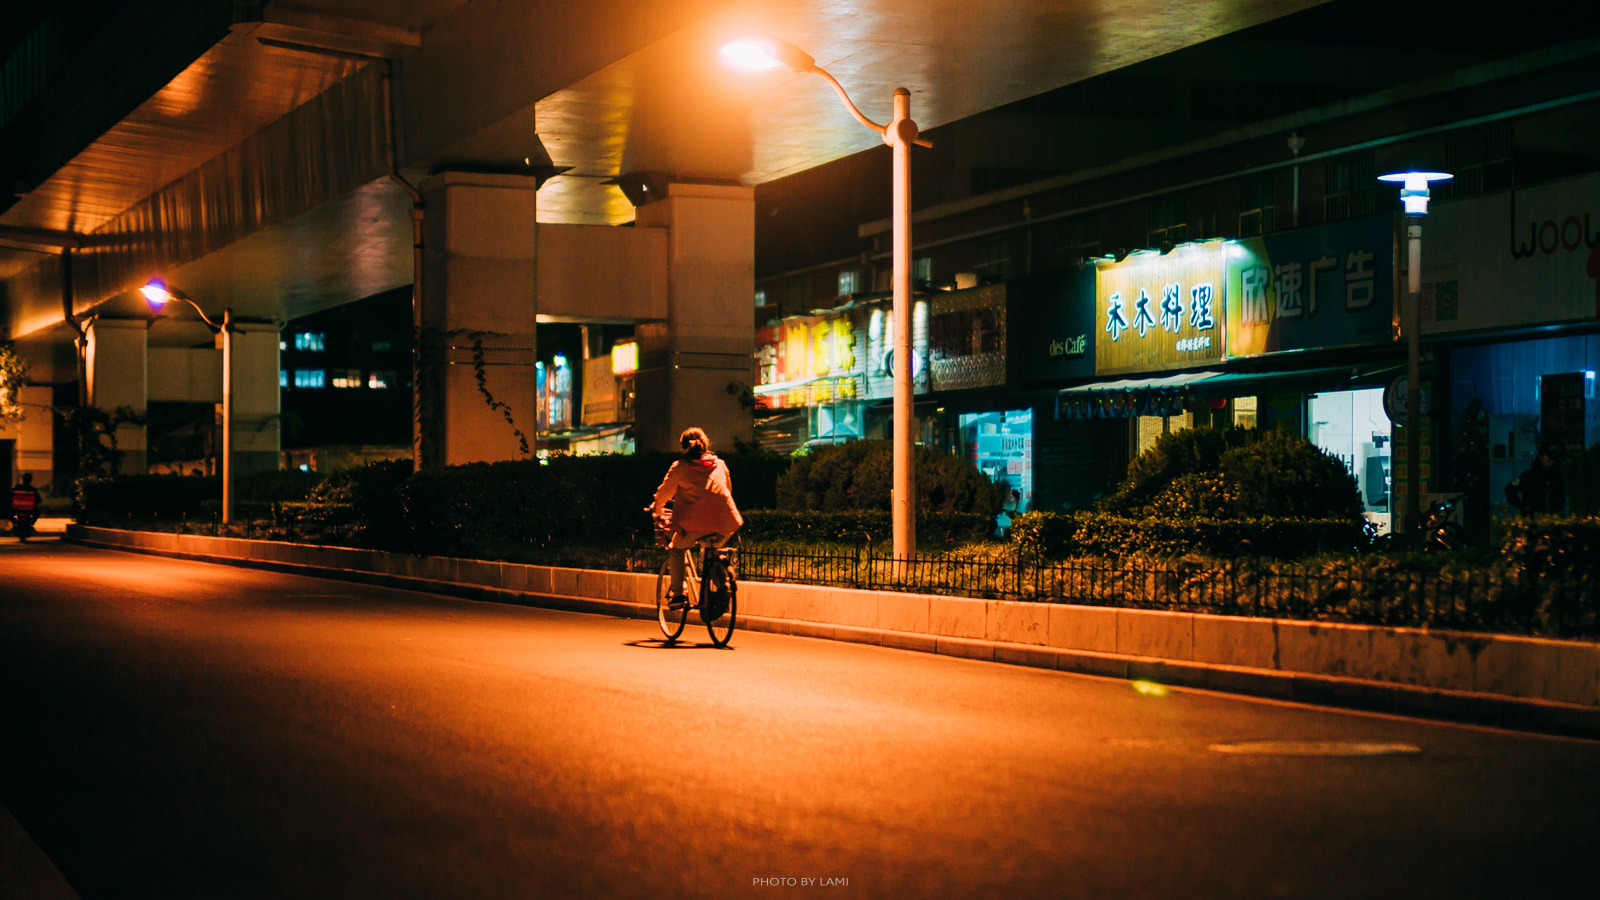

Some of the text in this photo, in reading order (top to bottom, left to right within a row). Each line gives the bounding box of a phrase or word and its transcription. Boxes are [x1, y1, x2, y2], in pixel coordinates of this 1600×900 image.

[1105, 282, 1214, 341] 禾木料理
[1240, 249, 1376, 326] 欣速广告
[1049, 334, 1085, 356] des Café
